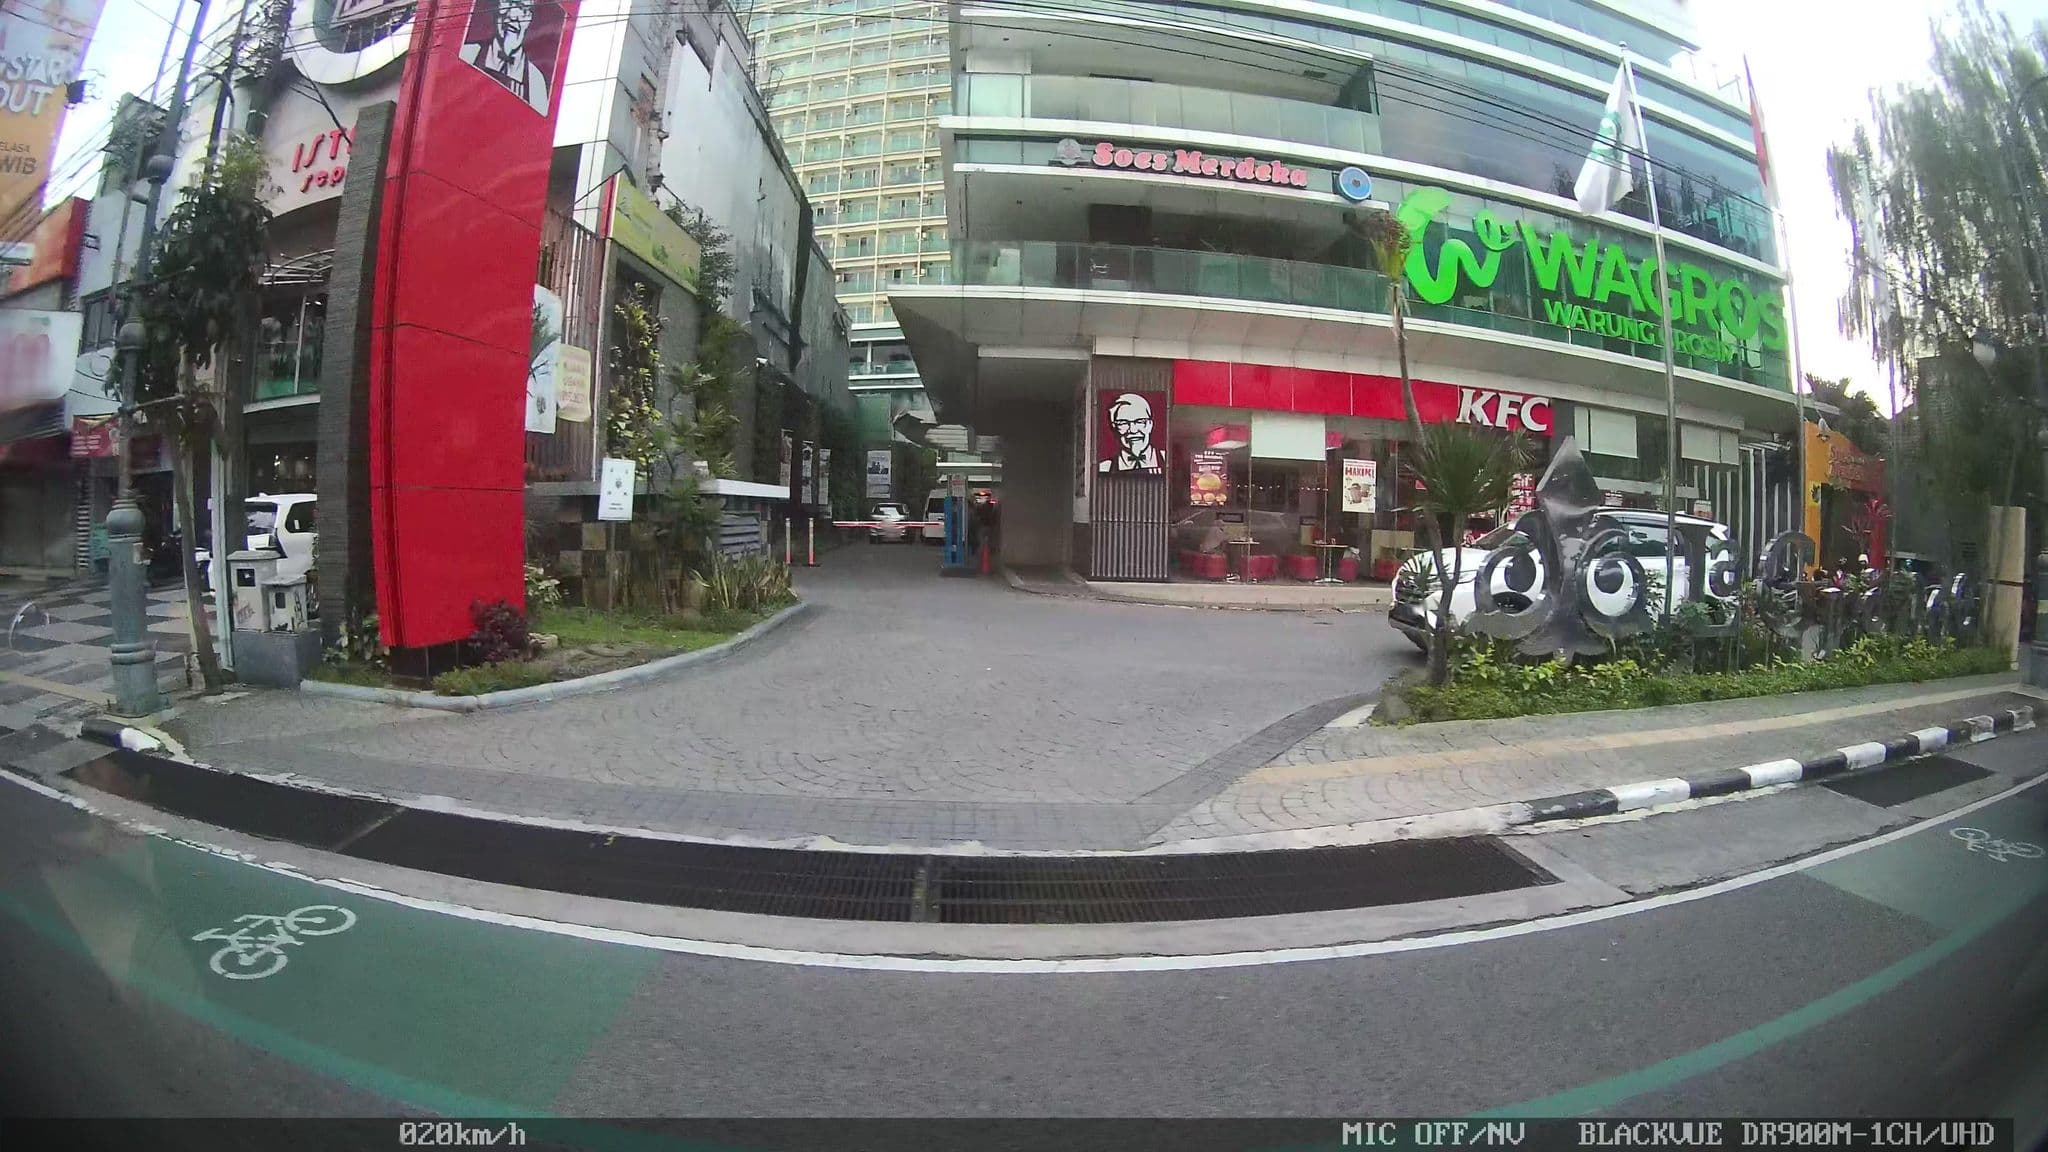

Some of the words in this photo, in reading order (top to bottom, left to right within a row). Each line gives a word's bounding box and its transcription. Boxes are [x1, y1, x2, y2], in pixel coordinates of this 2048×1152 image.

[1093, 142, 1168, 171] Soes
[1172, 150, 1308, 187] Merdeka
[1515, 219, 1788, 350] WAGROS
[1543, 298, 1656, 345] WARUNG
[1456, 388, 1550, 432] KFC
